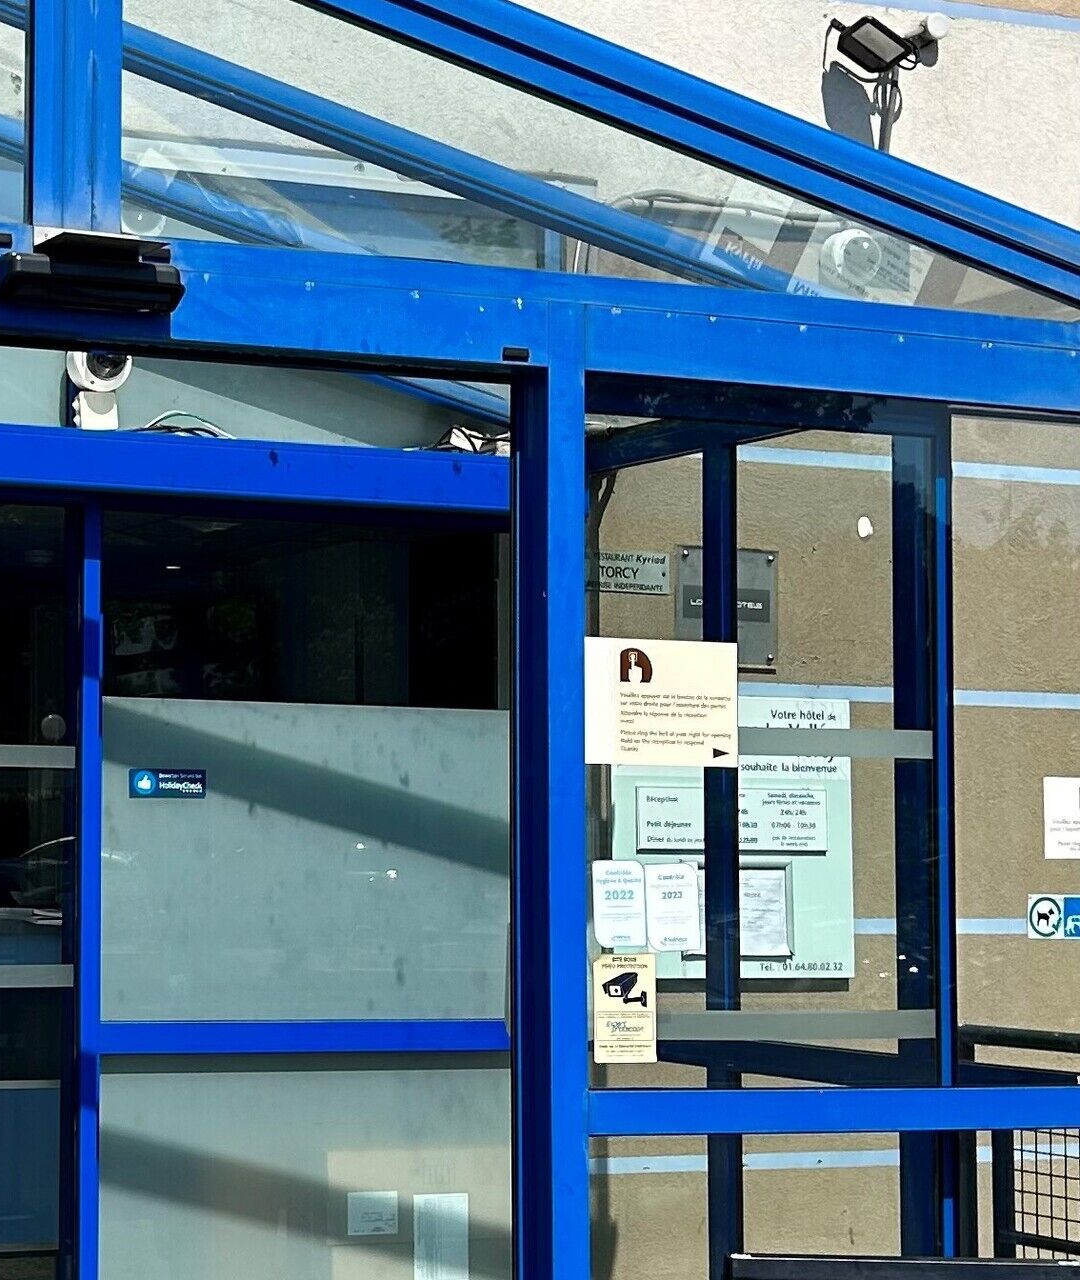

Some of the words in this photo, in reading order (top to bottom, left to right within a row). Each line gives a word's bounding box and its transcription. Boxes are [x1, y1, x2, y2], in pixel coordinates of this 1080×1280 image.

[636, 554, 665, 567] Kyriad
[599, 565, 639, 579] TORCY
[771, 709, 797, 720] Votre
[800, 710, 824, 720] hôtel
[740, 762, 778, 772] souhaite
[782, 762, 789, 772] la
[792, 763, 838, 773] bienvenue
[604, 890, 635, 900] 2022
[661, 891, 683, 900] 2023
[782, 962, 844, 972] 01.64.80.02.32
